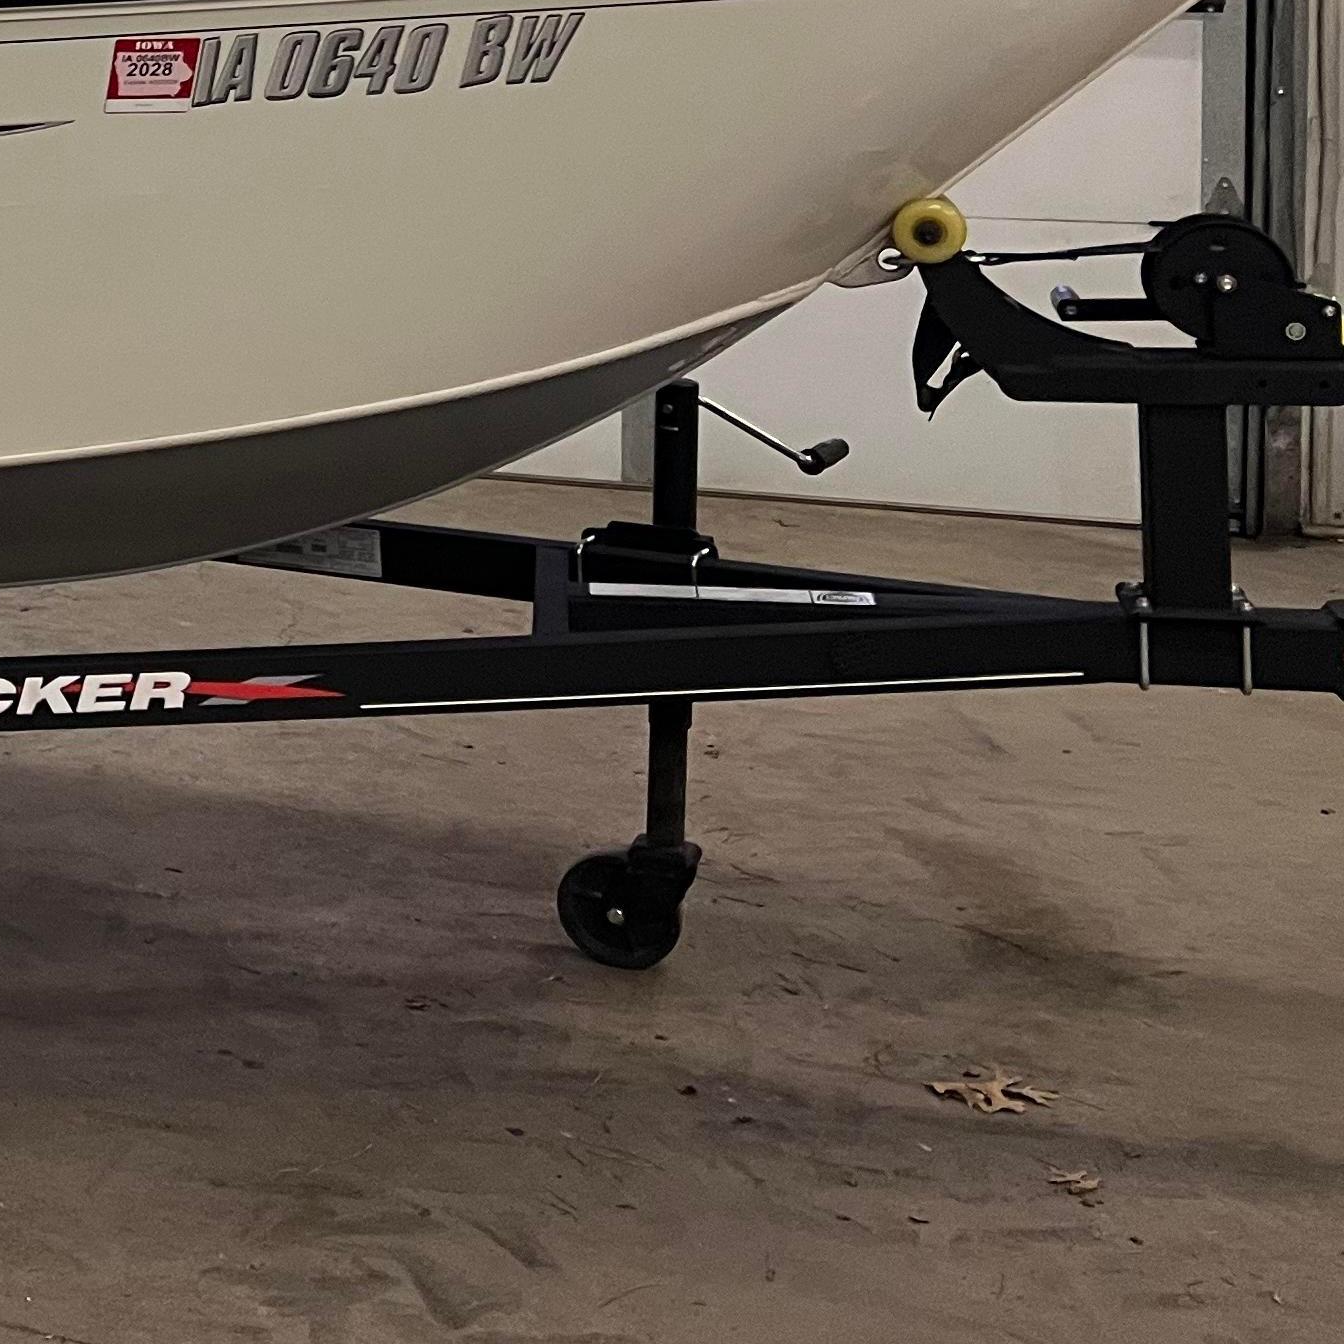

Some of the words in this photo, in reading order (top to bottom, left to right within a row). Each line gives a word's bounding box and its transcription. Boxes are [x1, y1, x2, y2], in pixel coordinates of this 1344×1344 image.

[135, 41, 174, 50] IOWA
[191, 32, 259, 107] IA
[264, 22, 448, 102] 0640
[459, 12, 585, 89] BW
[126, 62, 173, 77] 2028
